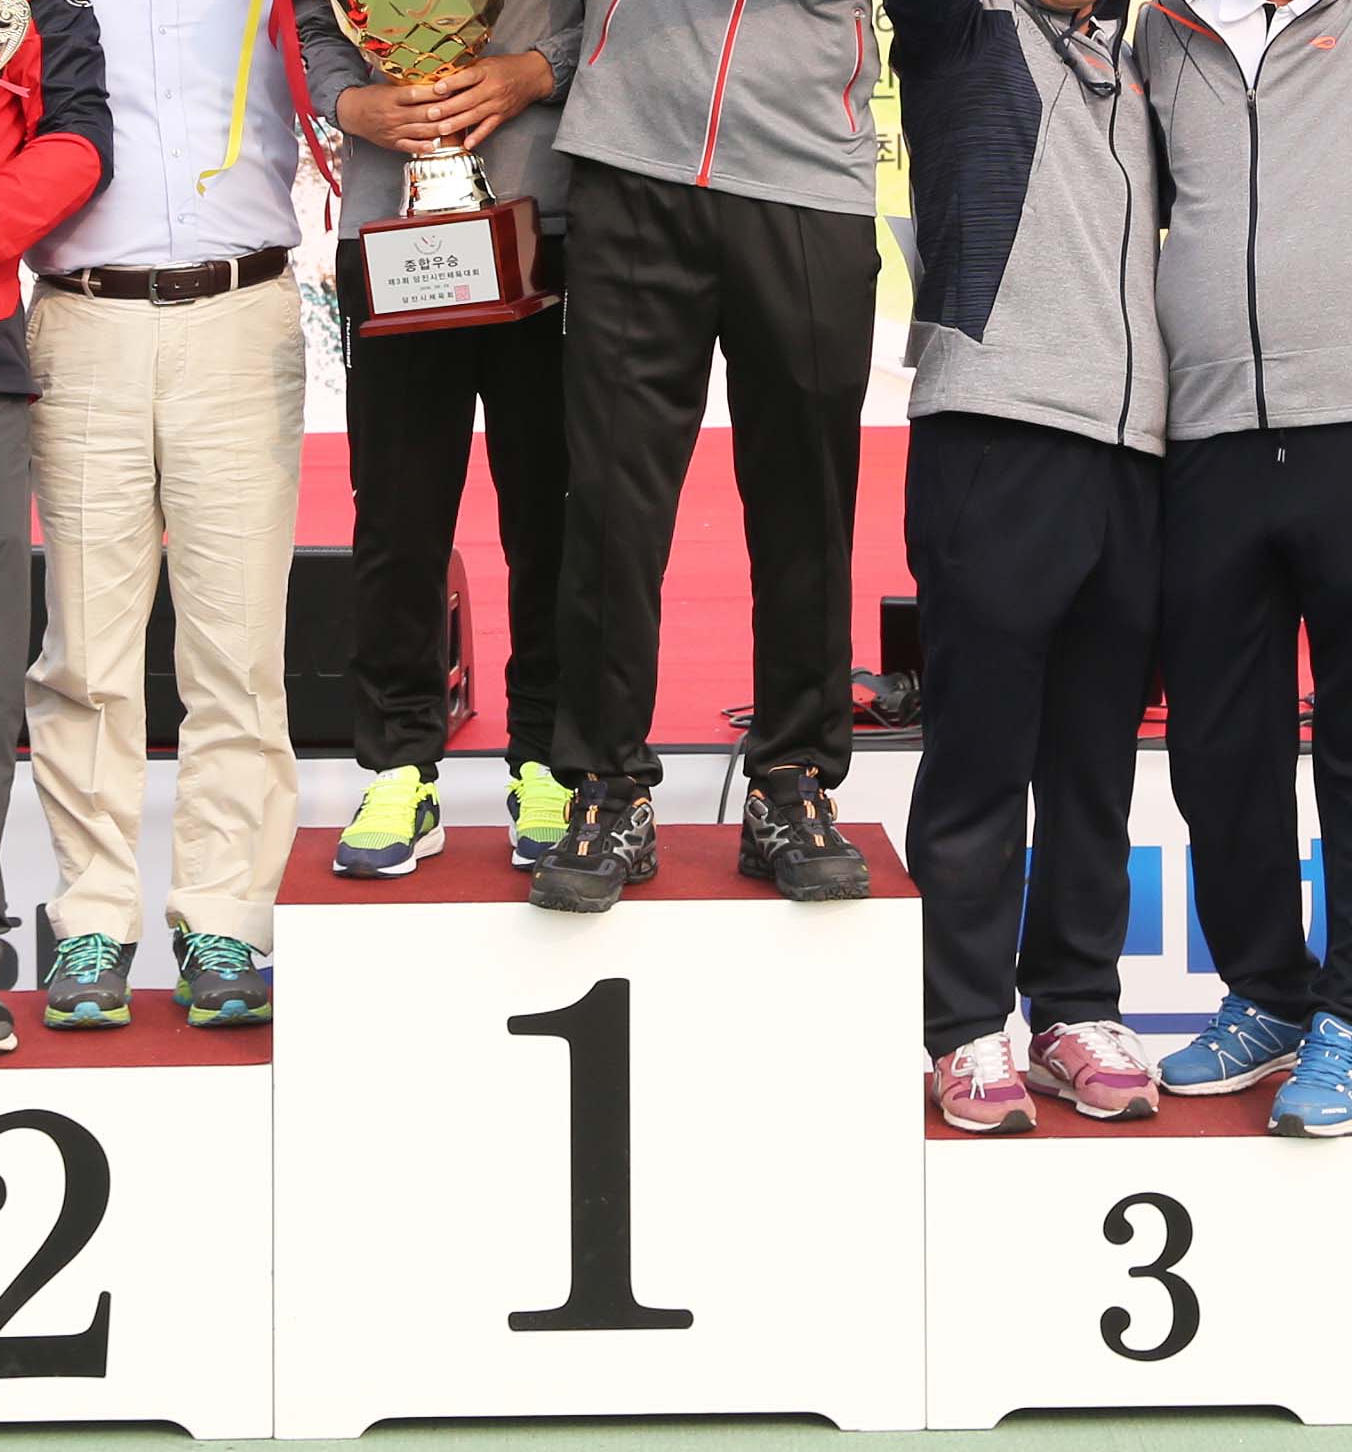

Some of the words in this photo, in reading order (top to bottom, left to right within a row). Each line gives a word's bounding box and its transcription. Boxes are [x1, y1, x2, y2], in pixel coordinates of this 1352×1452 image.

[404, 255, 459, 273] 종합우승
[506, 977, 694, 1331] 1
[1099, 1191, 1200, 1362] 3
